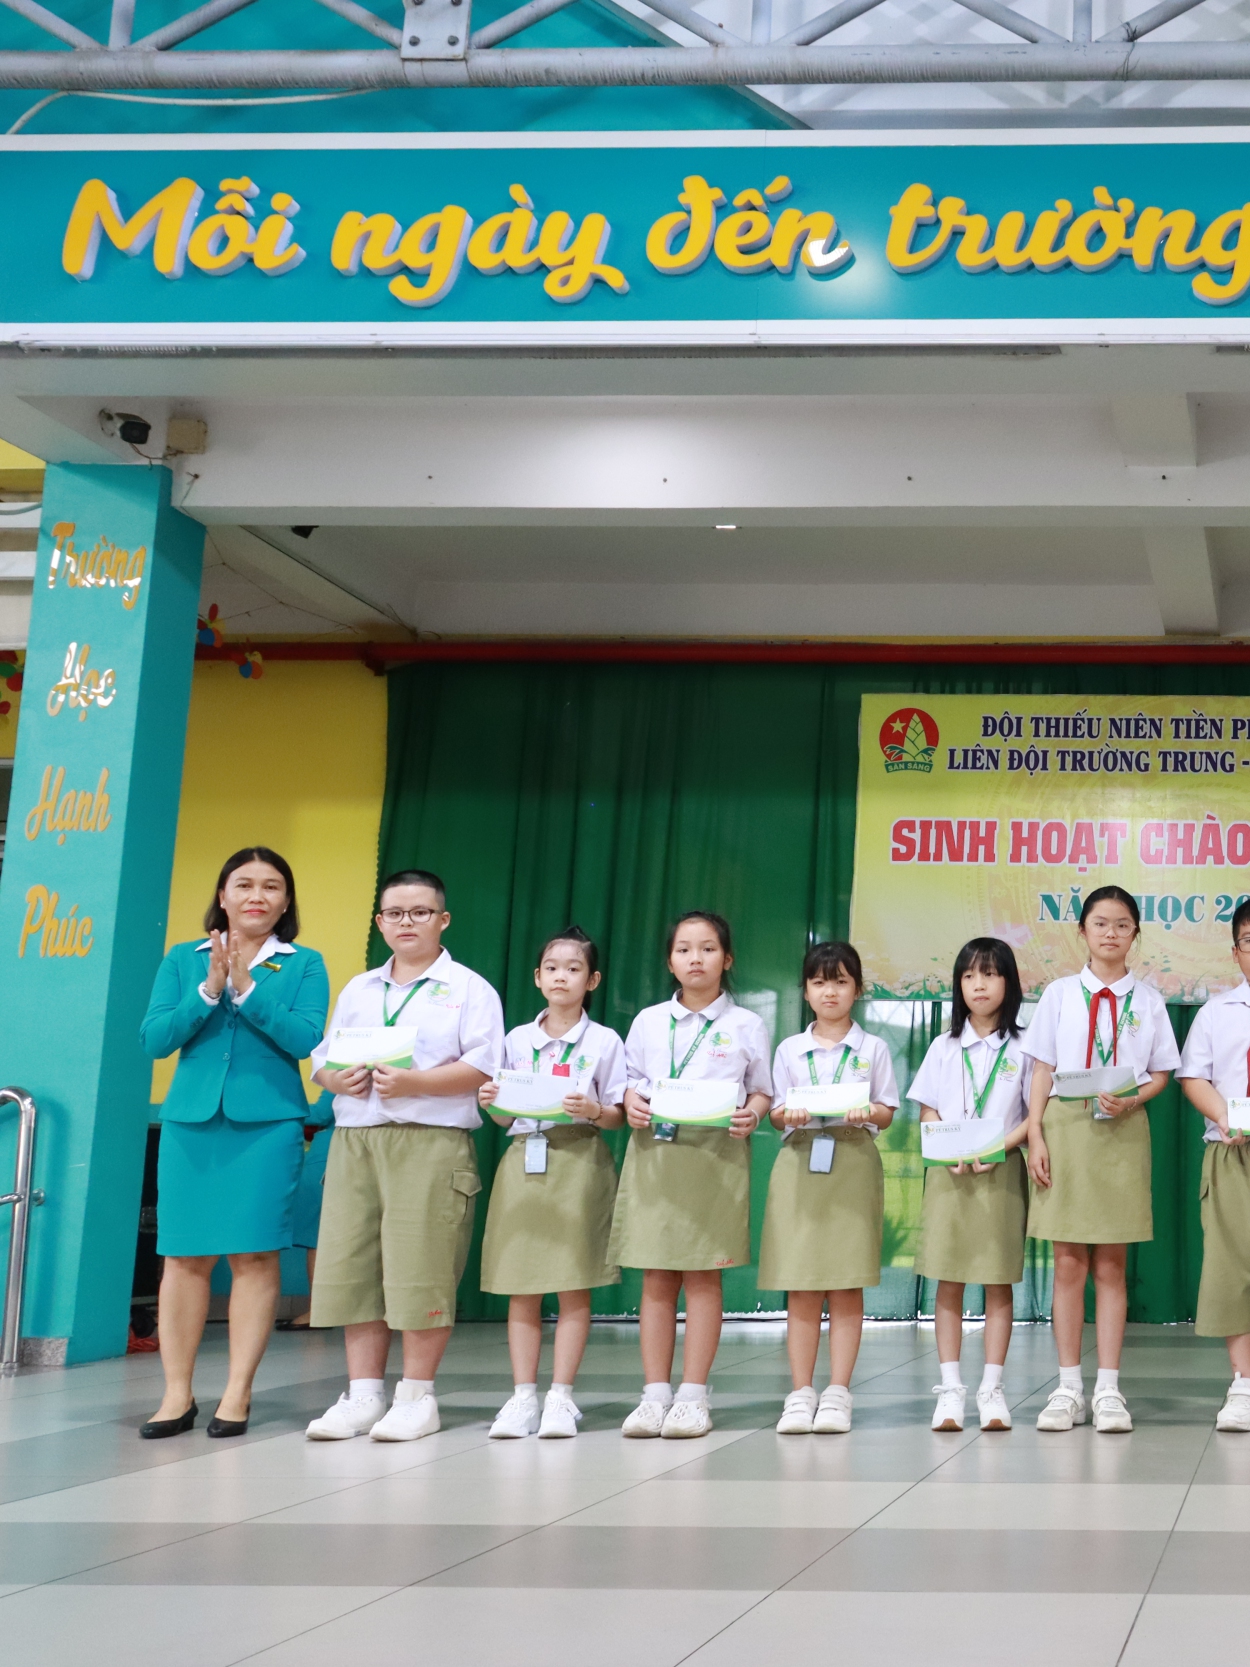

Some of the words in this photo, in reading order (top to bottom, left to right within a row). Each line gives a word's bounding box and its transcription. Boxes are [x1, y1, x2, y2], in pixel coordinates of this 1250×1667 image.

[64, 176, 302, 278] Mỗi
[331, 184, 628, 305] ngày
[646, 176, 852, 272] đến
[49, 521, 146, 609] Trường
[47, 641, 117, 722] Học
[947, 744, 1001, 771] LIÊN
[1007, 745, 1050, 776] ĐỘI
[1056, 743, 1151, 773] TRƯỜNG
[1157, 751, 1235, 774] TRUNG
[981, 711, 1023, 742] ĐỘI
[1030, 709, 1101, 739] THIẾU
[1108, 713, 1163, 740] NIÊN
[1170, 709, 1224, 740] TIỀN
[25, 765, 112, 846] Hạnh
[891, 819, 998, 863] SINH
[1009, 821, 1127, 873] HOẠT
[18, 884, 94, 959] Phúc
[1039, 886, 1083, 922] NĂ
[1134, 895, 1206, 931] HỌC
